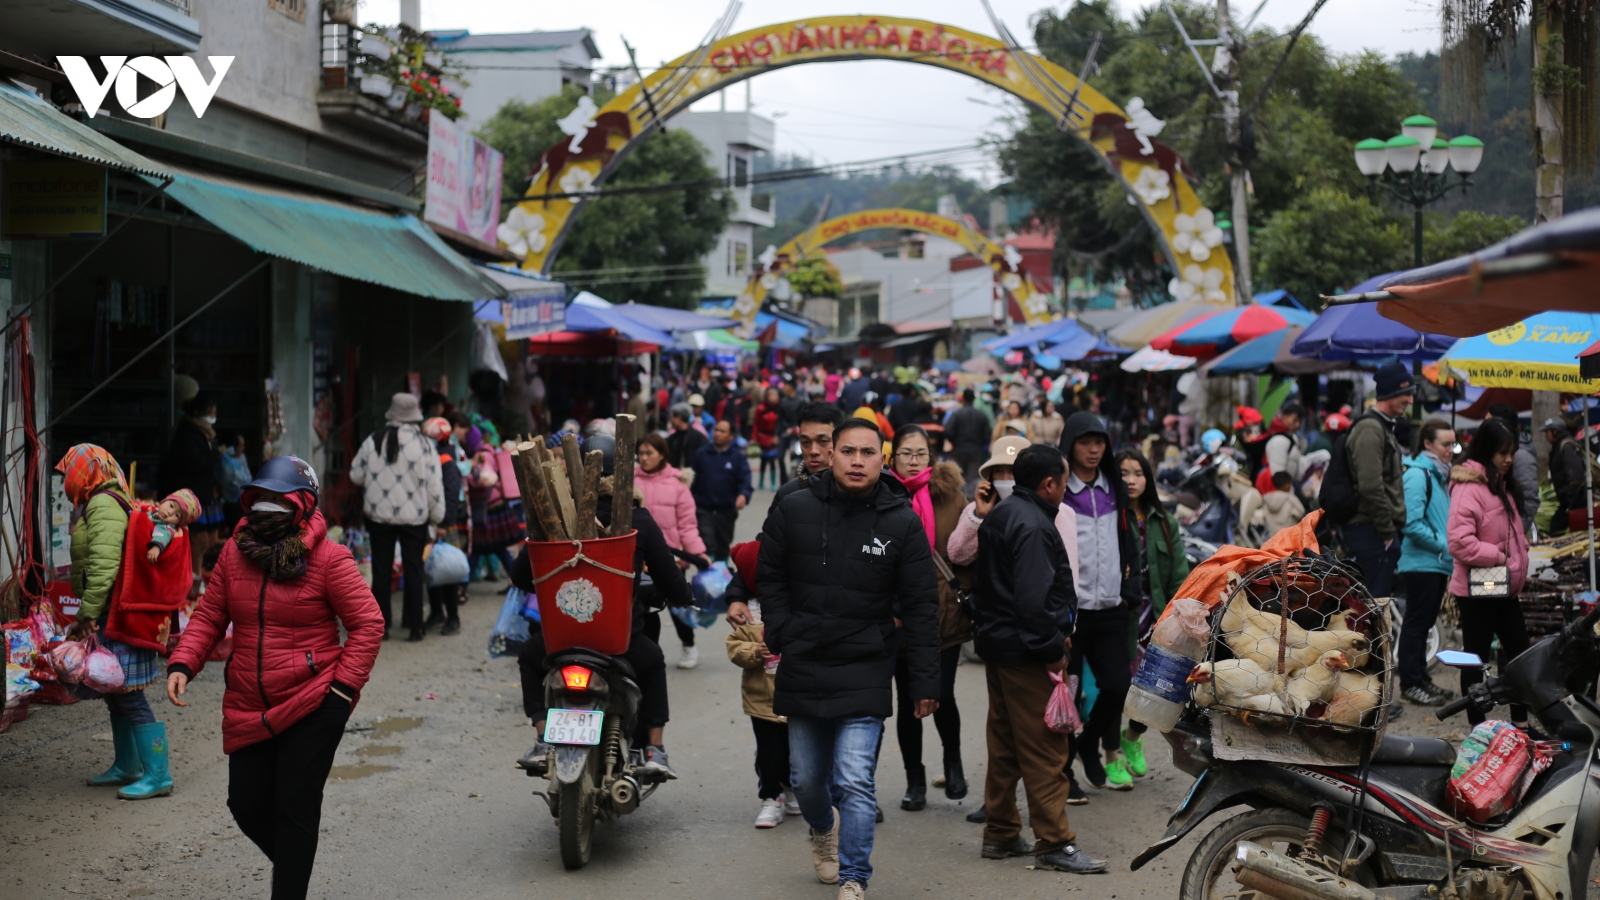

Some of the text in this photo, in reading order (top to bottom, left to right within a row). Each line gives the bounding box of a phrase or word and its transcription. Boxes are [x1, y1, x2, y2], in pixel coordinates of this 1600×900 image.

[711, 33, 773, 73] CHỢ
[776, 22, 836, 54] VĂN
[10, 176, 99, 193] mobifone
[58, 206, 76, 215] SIM
[1525, 331, 1591, 344] XANH
[1480, 366, 1495, 378] TRẢ
[1497, 367, 1514, 378] GÓP
[1537, 370, 1560, 382] HÀNG
[1006, 445, 1016, 456] C
[555, 712, 593, 727] 24-B1
[548, 727, 598, 743] 851.40
